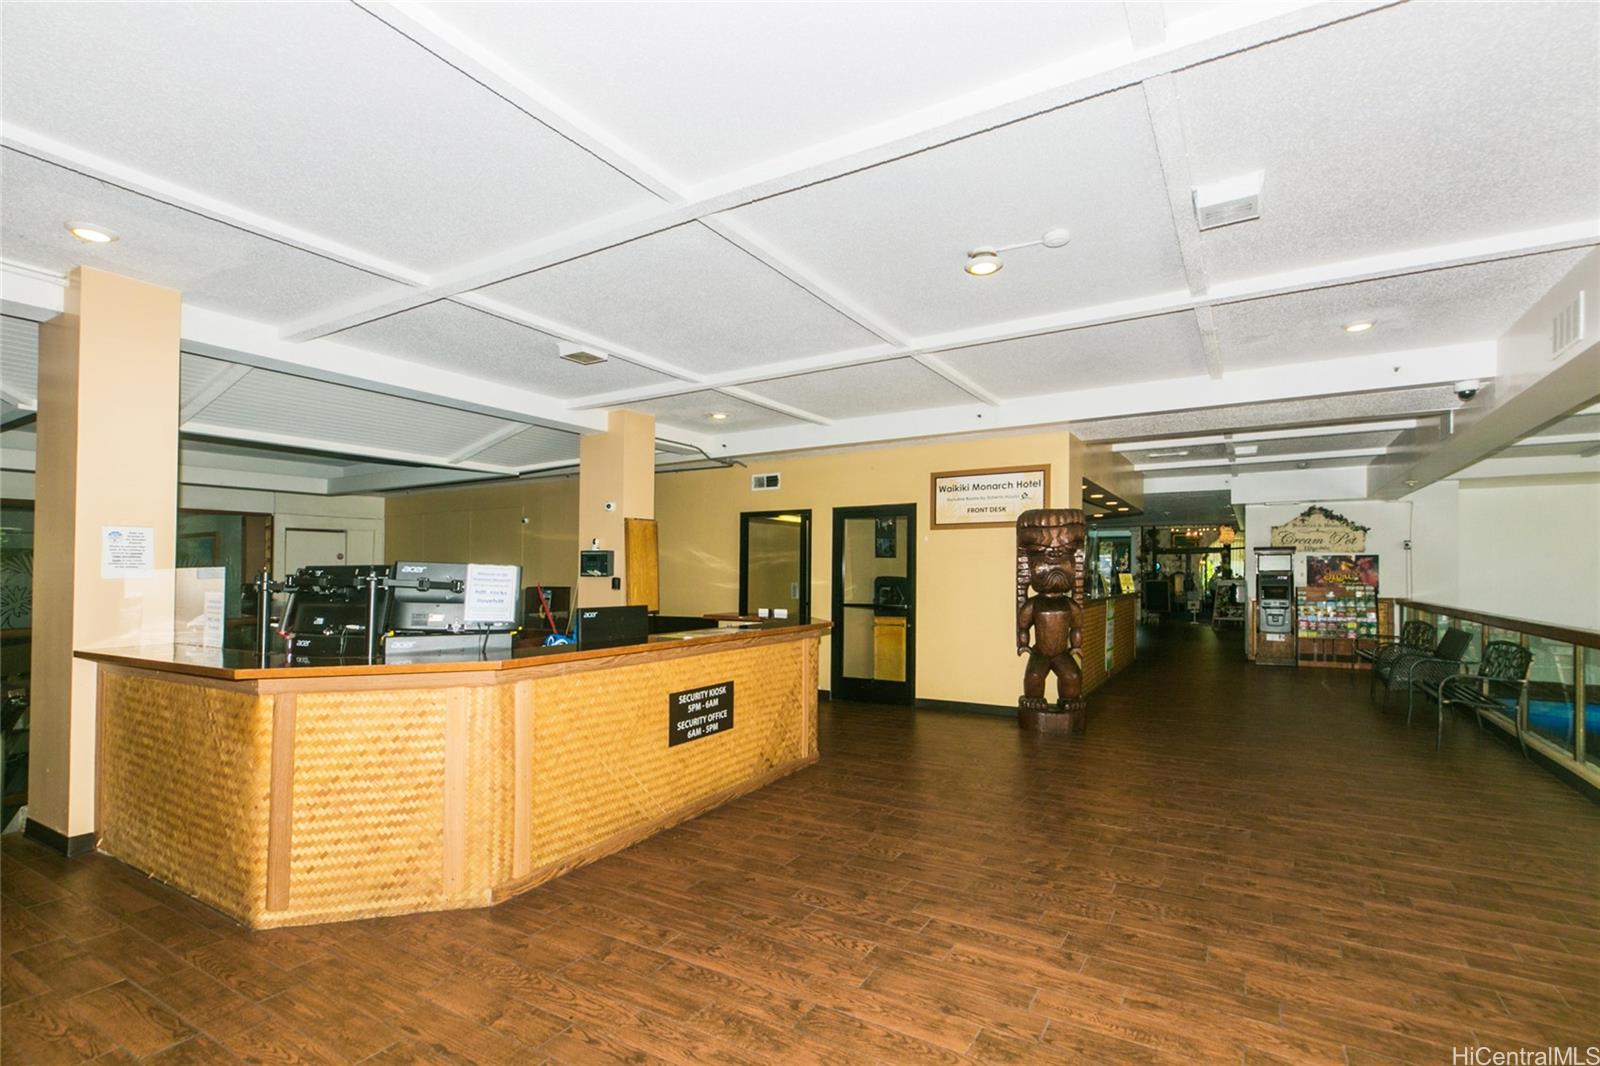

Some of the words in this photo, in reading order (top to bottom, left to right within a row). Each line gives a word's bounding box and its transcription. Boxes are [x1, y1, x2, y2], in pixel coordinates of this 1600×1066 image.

[938, 484, 970, 493] Waikiki
[971, 482, 1014, 491] Monarch
[1016, 480, 1041, 488] Hotel
[1278, 530, 1324, 545] Cream
[401, 565, 427, 574] acer
[296, 639, 311, 647] acer
[391, 641, 417, 649] acer
[678, 690, 709, 704] SECURITY
[709, 686, 727, 696] KIOSK
[687, 702, 702, 713] 5PM
[705, 698, 719, 709] 6AM
[677, 715, 707, 731] SECURITY
[707, 709, 728, 722] OFFICE
[687, 727, 702, 739] 6AM
[705, 722, 719, 734] 5PM
